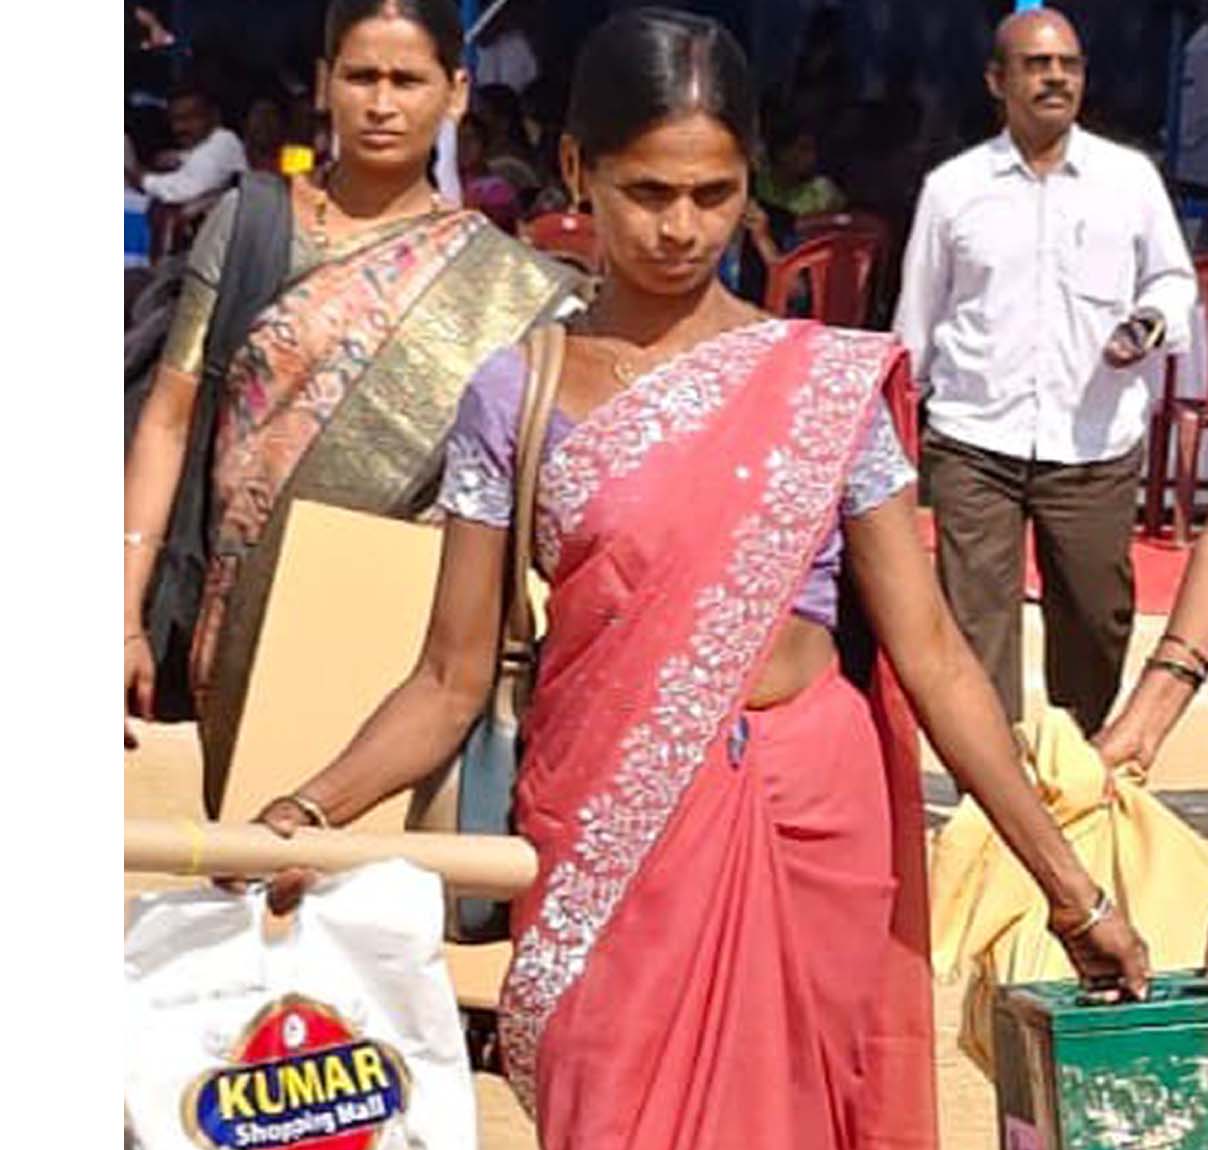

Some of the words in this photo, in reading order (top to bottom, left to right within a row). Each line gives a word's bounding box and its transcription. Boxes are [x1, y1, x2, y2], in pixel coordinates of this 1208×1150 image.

[218, 1047, 390, 1120] KUMAR
[235, 1111, 337, 1146] Shopping
[335, 1093, 386, 1126] Mall
